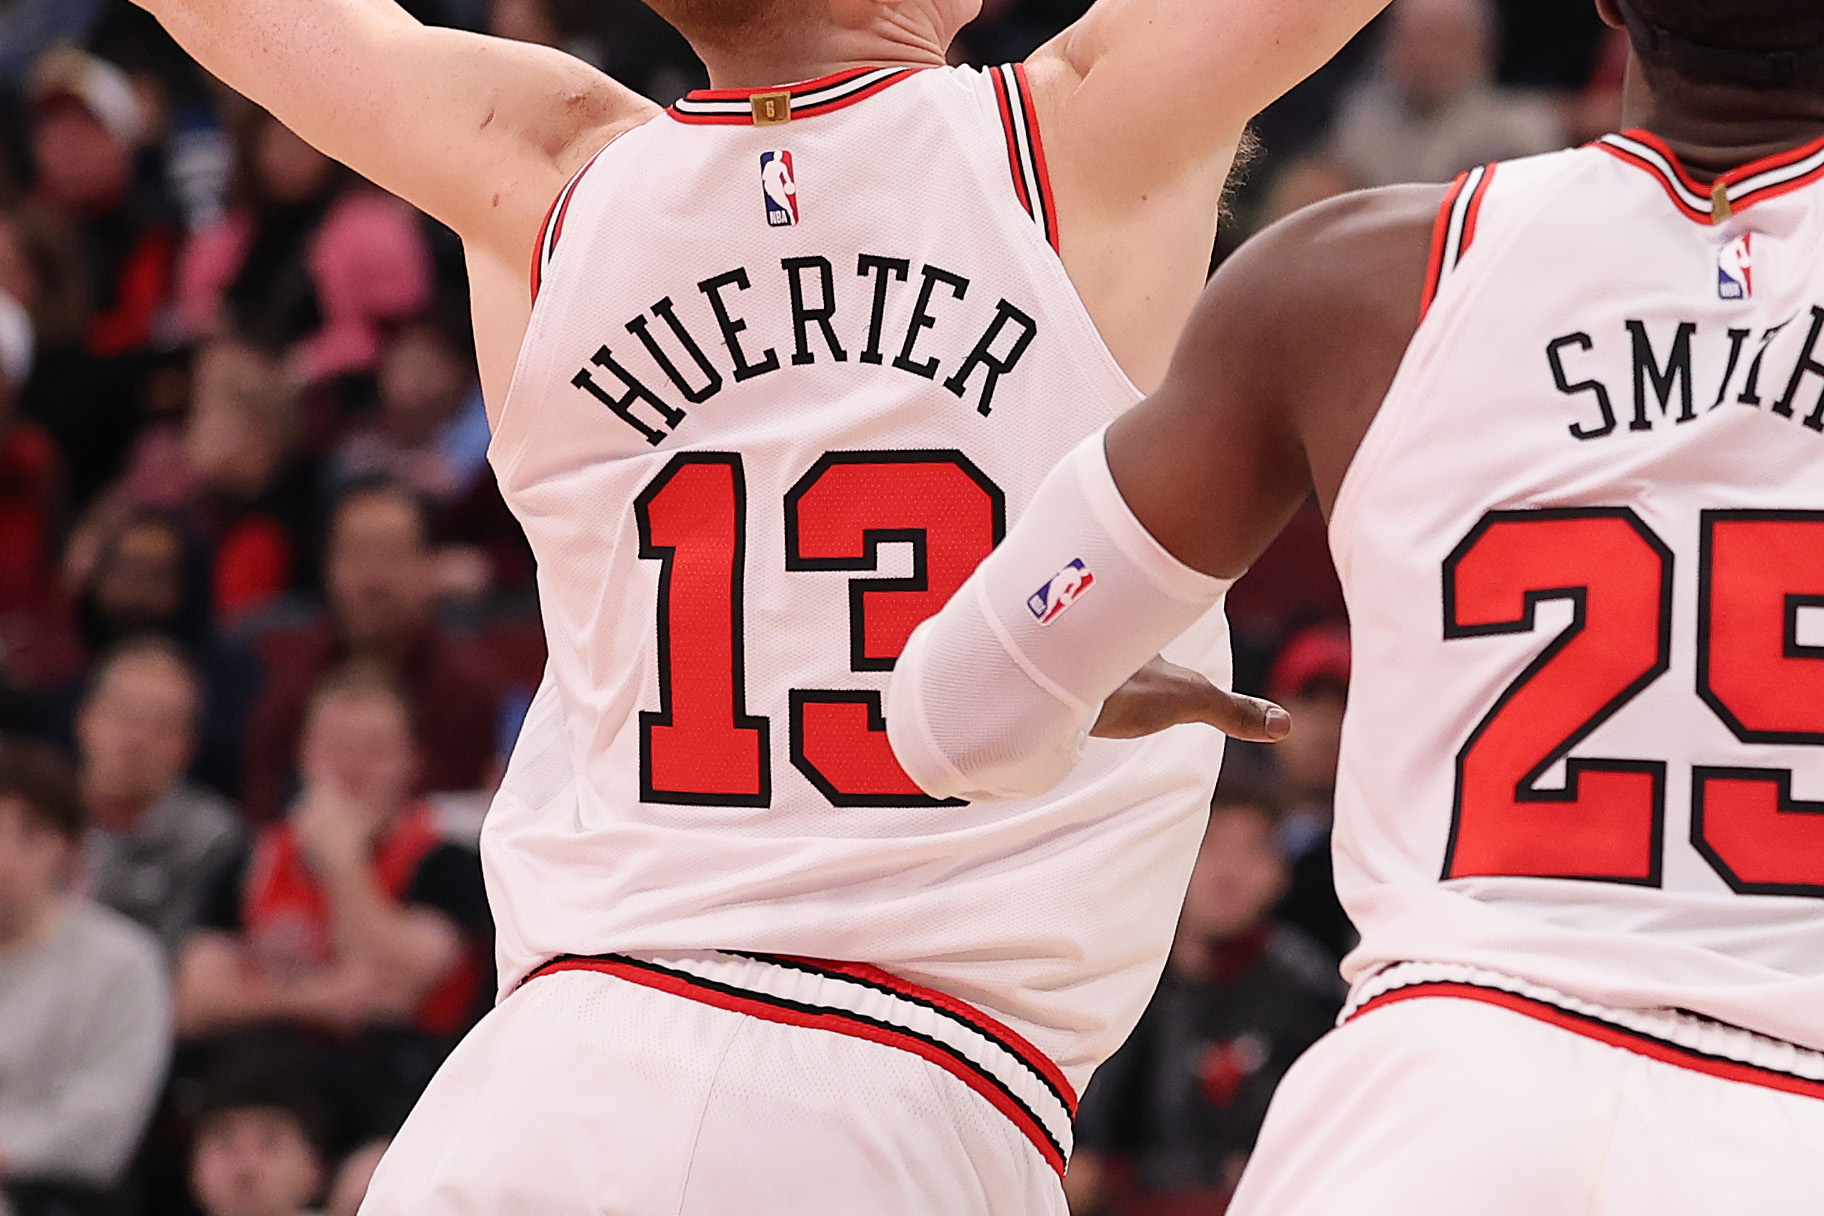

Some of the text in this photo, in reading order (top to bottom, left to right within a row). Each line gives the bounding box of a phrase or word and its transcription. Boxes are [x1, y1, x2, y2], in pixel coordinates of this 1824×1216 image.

[769, 210, 788, 224] NBA
[571, 254, 1036, 446] HUERTER
[633, 449, 1006, 809] 13
